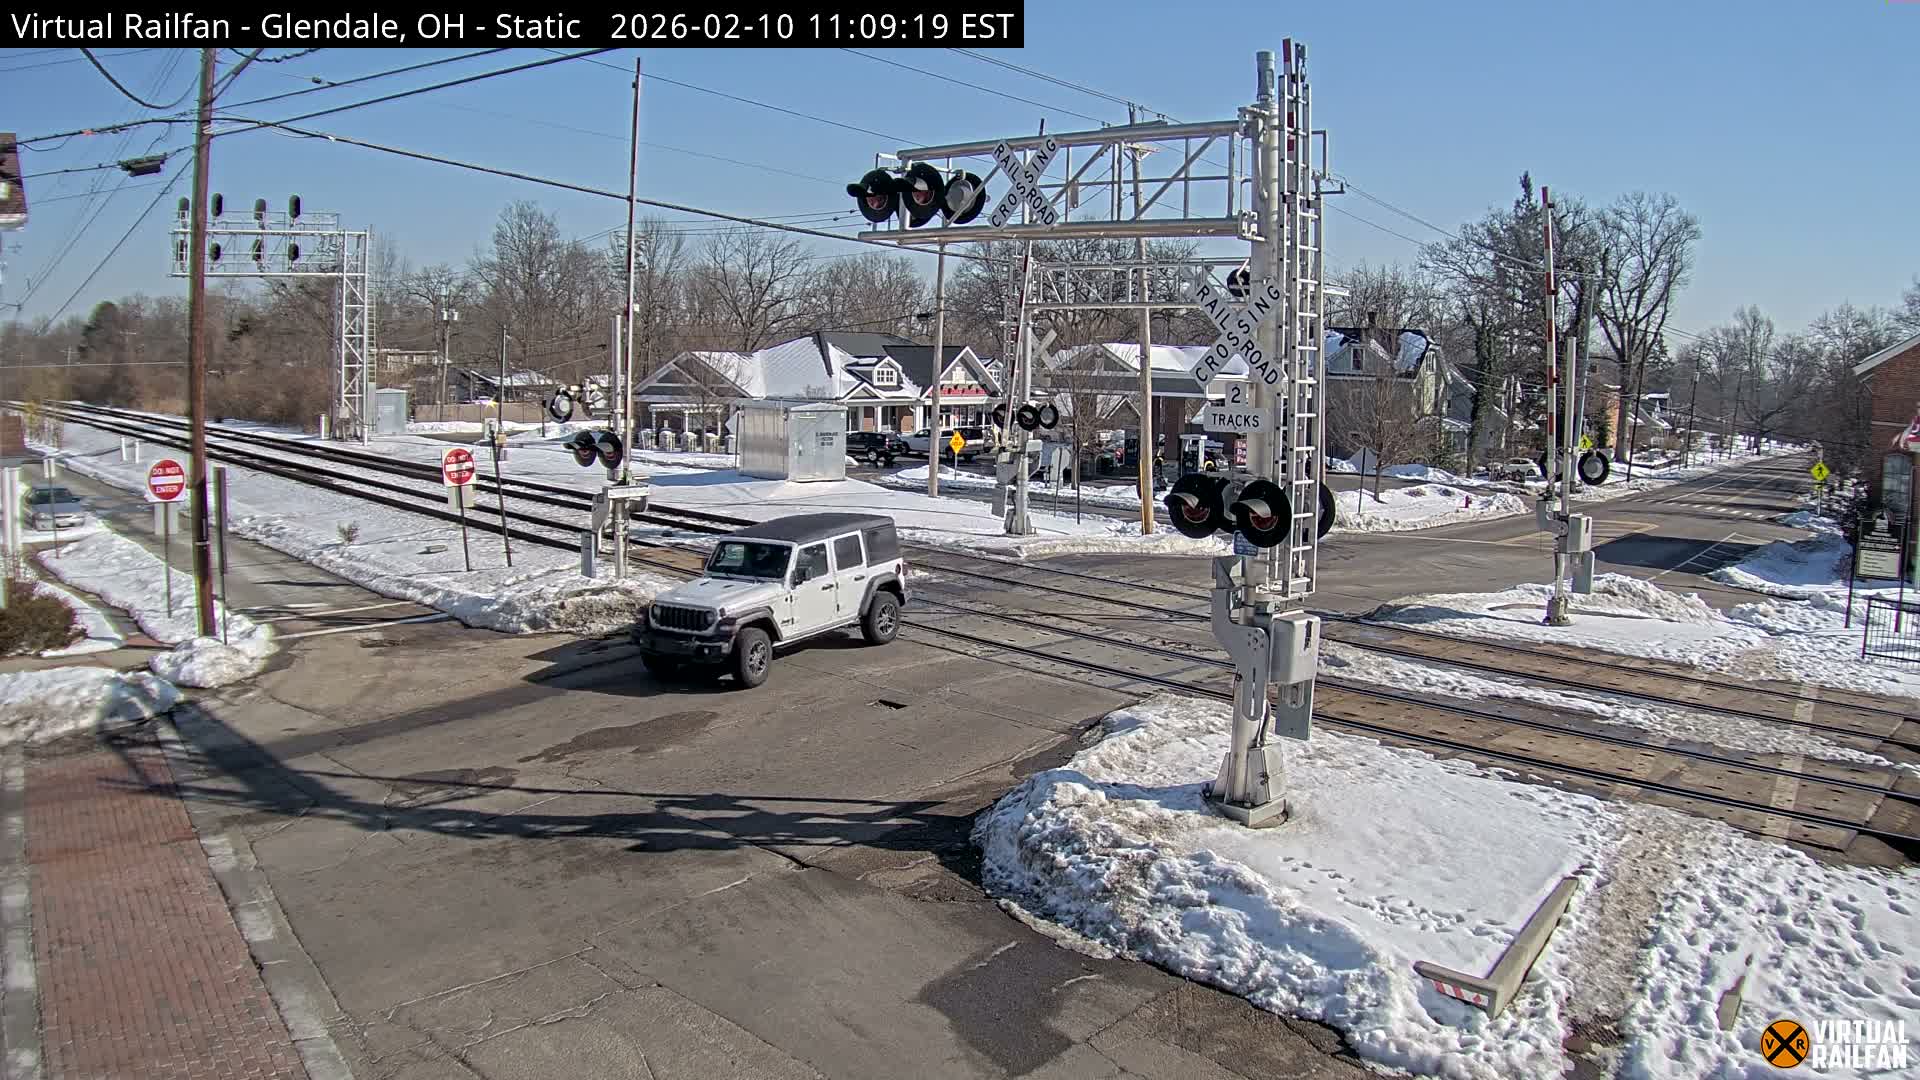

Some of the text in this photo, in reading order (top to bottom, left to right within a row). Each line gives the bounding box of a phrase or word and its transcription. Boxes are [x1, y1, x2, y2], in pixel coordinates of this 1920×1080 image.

[991, 139, 1056, 228] CROSSING
[994, 143, 1055, 225] RAILROAD
[1195, 285, 1280, 382] CROSSING
[1196, 284, 1279, 385] RAILROAD
[1211, 413, 1260, 429] TRACKS
[1231, 386, 1241, 404] 2
